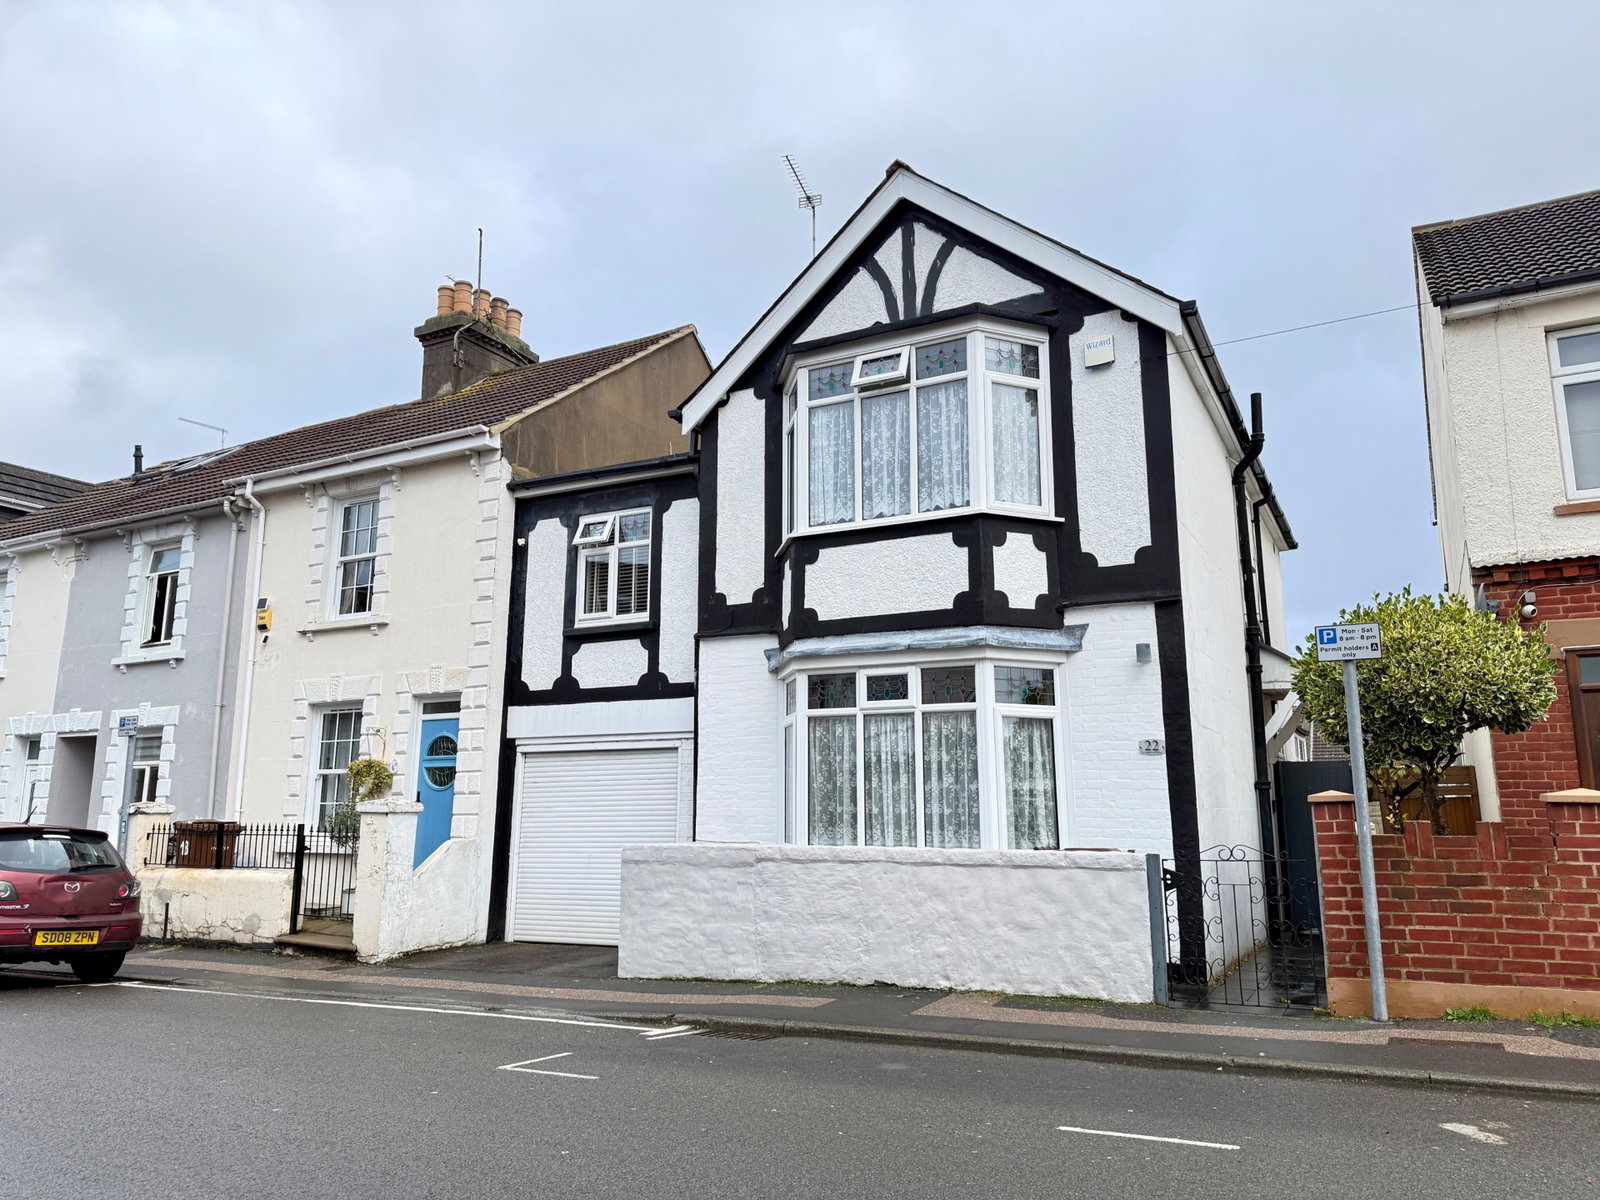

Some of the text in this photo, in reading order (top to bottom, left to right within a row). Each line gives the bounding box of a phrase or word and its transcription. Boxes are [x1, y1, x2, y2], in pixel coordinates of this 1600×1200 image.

[1086, 337, 1111, 350] Wizard
[1322, 630, 1334, 643] P
[1144, 739, 1159, 751] 22
[41, 931, 95, 943] SD08 ZPN
